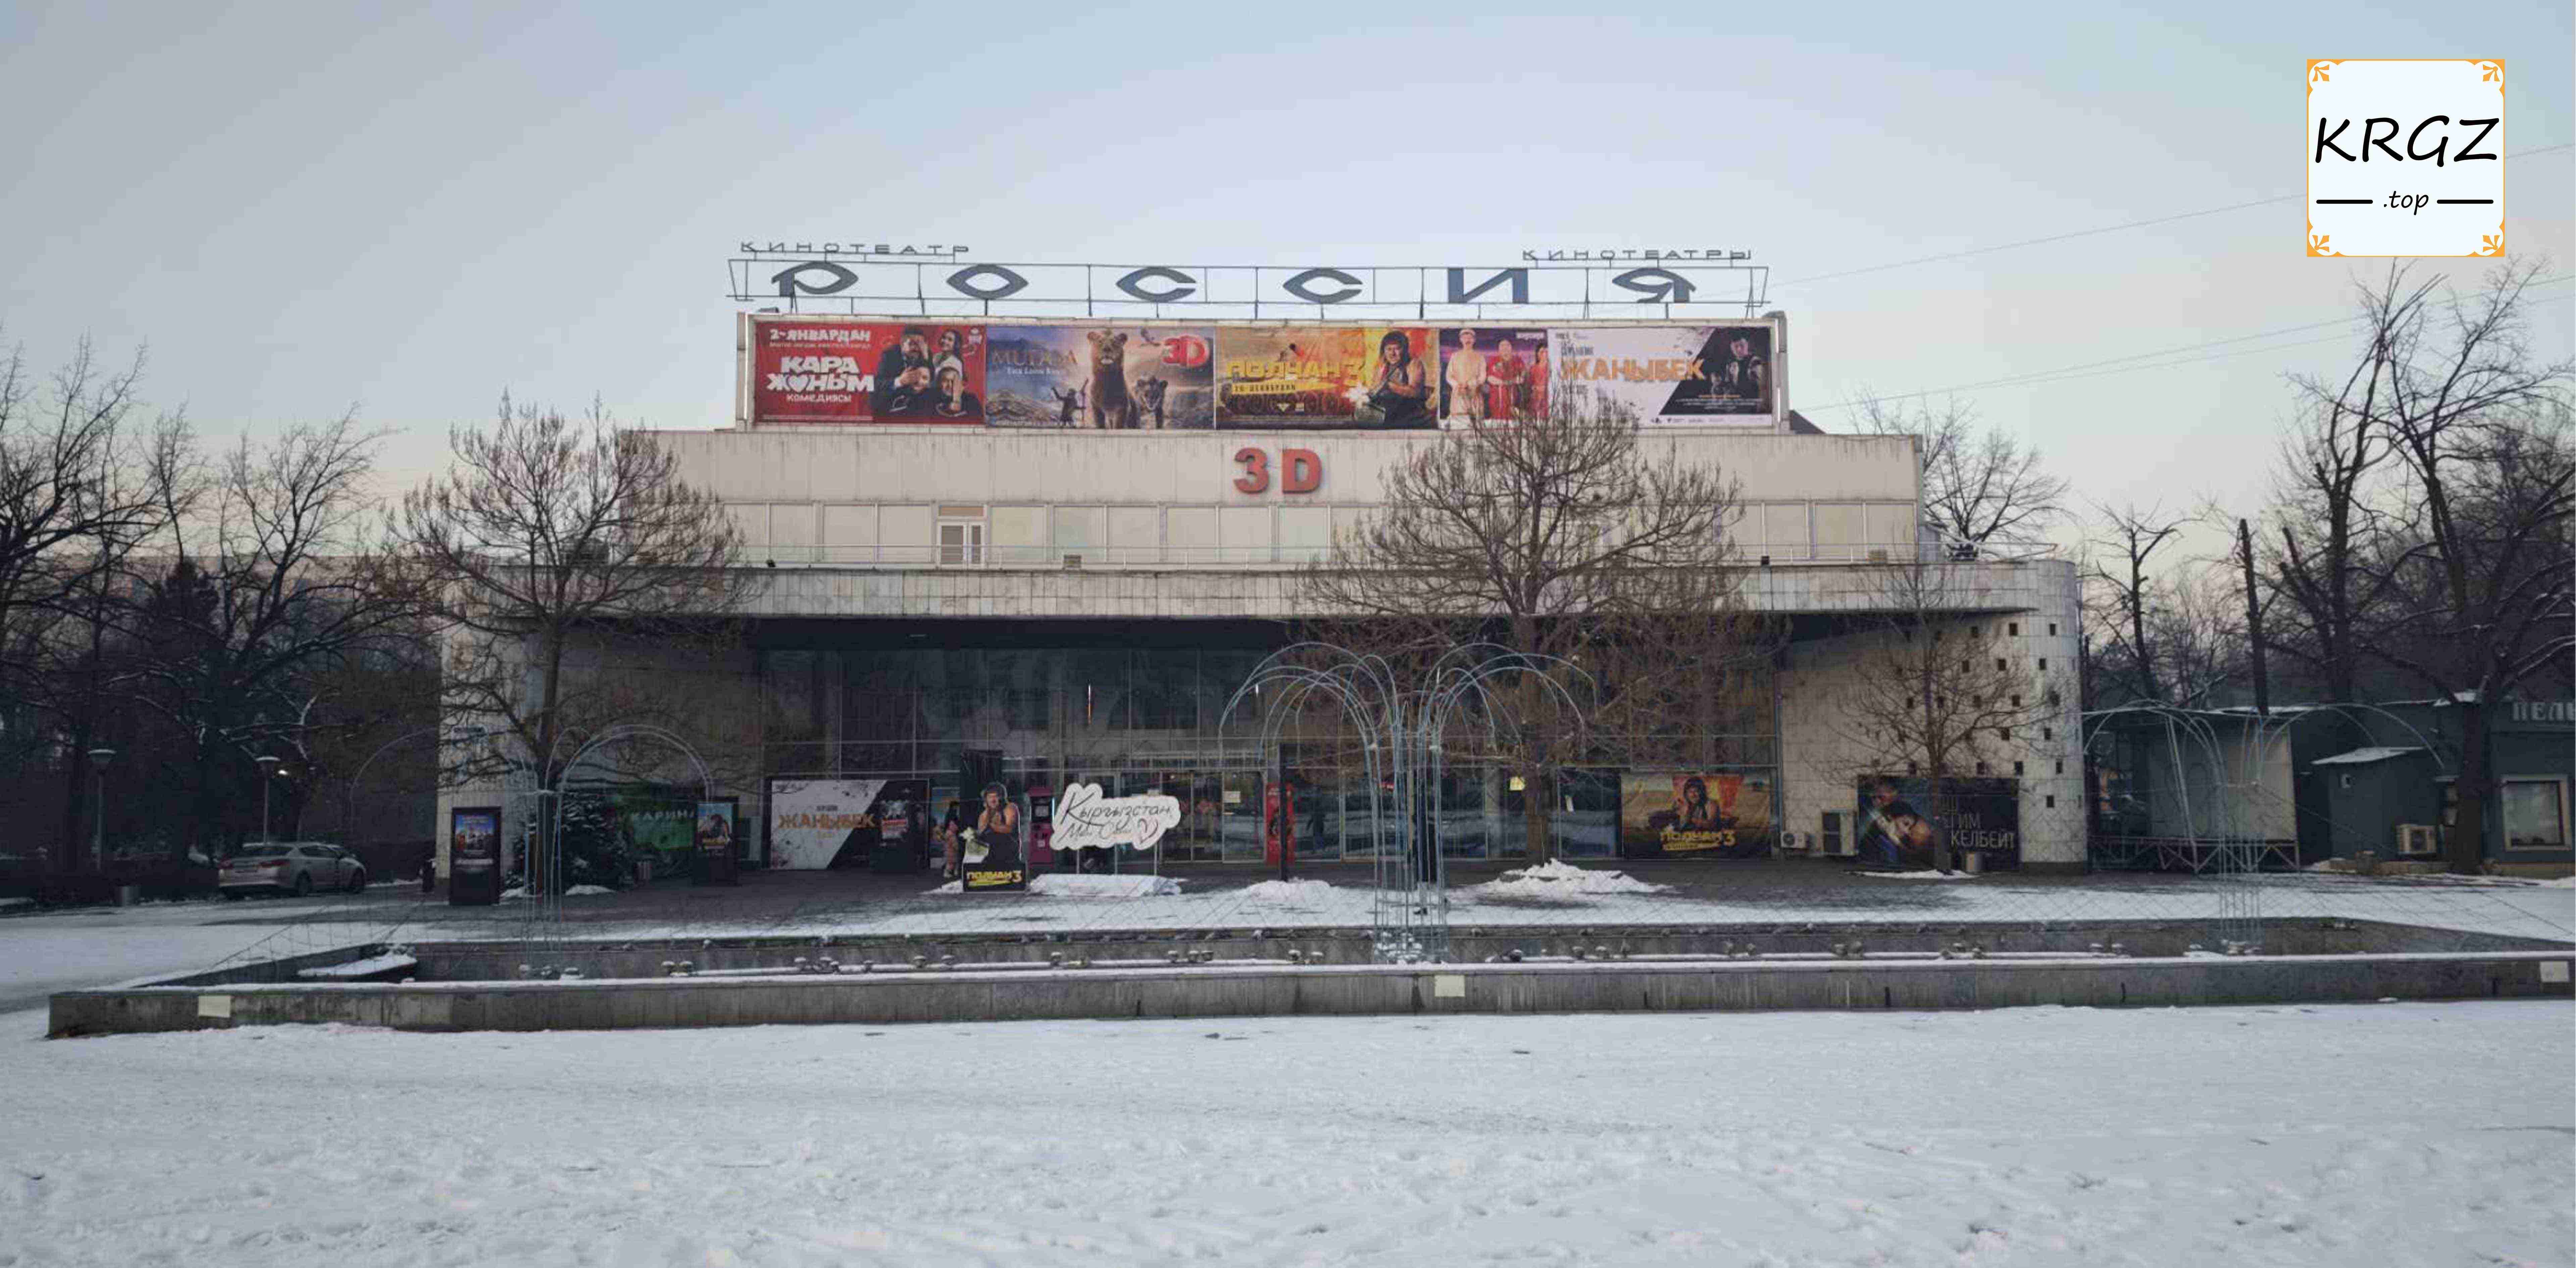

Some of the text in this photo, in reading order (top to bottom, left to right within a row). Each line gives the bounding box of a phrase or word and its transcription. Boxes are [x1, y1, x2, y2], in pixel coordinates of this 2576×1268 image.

[741, 242, 969, 254] КИНОТЕАТР
[1522, 250, 1751, 260] КИНОТЕАТРЫ
[772, 261, 1696, 304] РОССИЯ
[1162, 335, 1209, 367] 3D
[781, 356, 860, 374] КАРА
[1561, 358, 1705, 381] ЖАНЫБЕК
[1233, 447, 1322, 494] 3D
[1951, 827, 2015, 848] КЕЛБЕЙТ
[1012, 870, 1022, 883] 3
